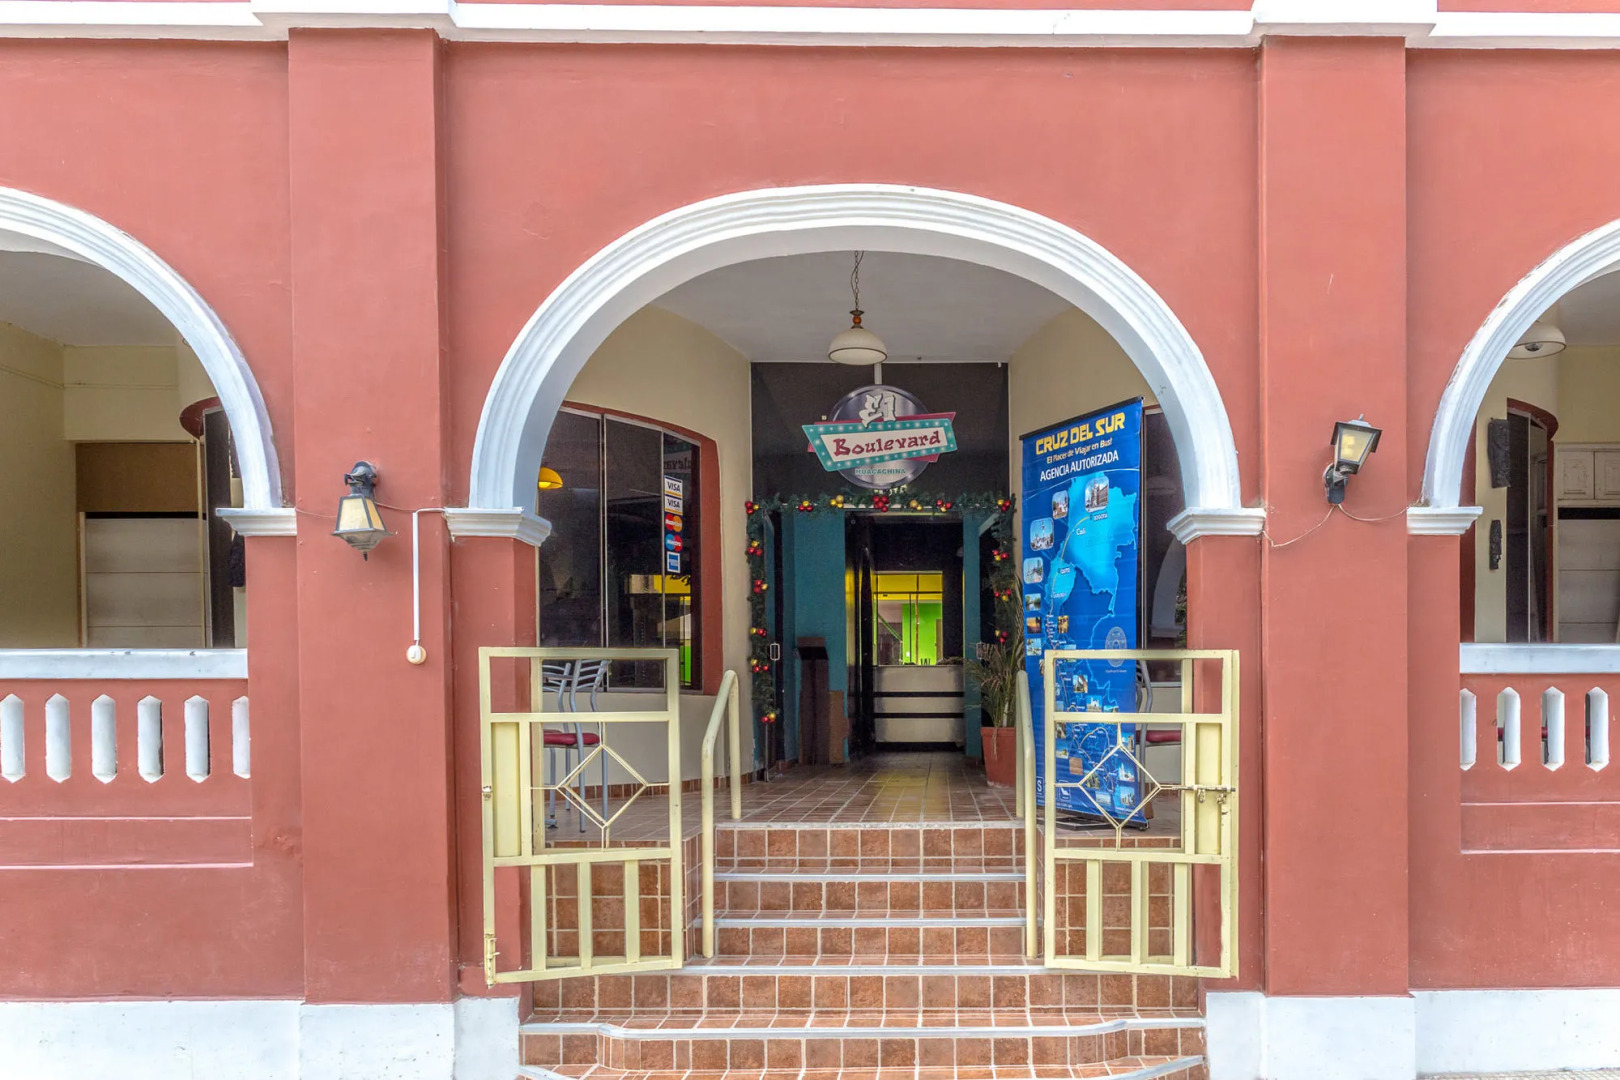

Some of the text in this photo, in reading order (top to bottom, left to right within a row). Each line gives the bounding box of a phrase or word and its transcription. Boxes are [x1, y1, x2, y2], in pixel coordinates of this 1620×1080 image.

[1036, 412, 1125, 455] CRUZ DEL SUR
[833, 431, 941, 457] Boulevard
[1074, 445, 1091, 457] Viajar
[855, 468, 906, 476] HUACACHINA
[1040, 450, 1119, 482] AGENCIA AUTORIZADA
[667, 482, 681, 493] VISA
[667, 498, 681, 508] VISA
